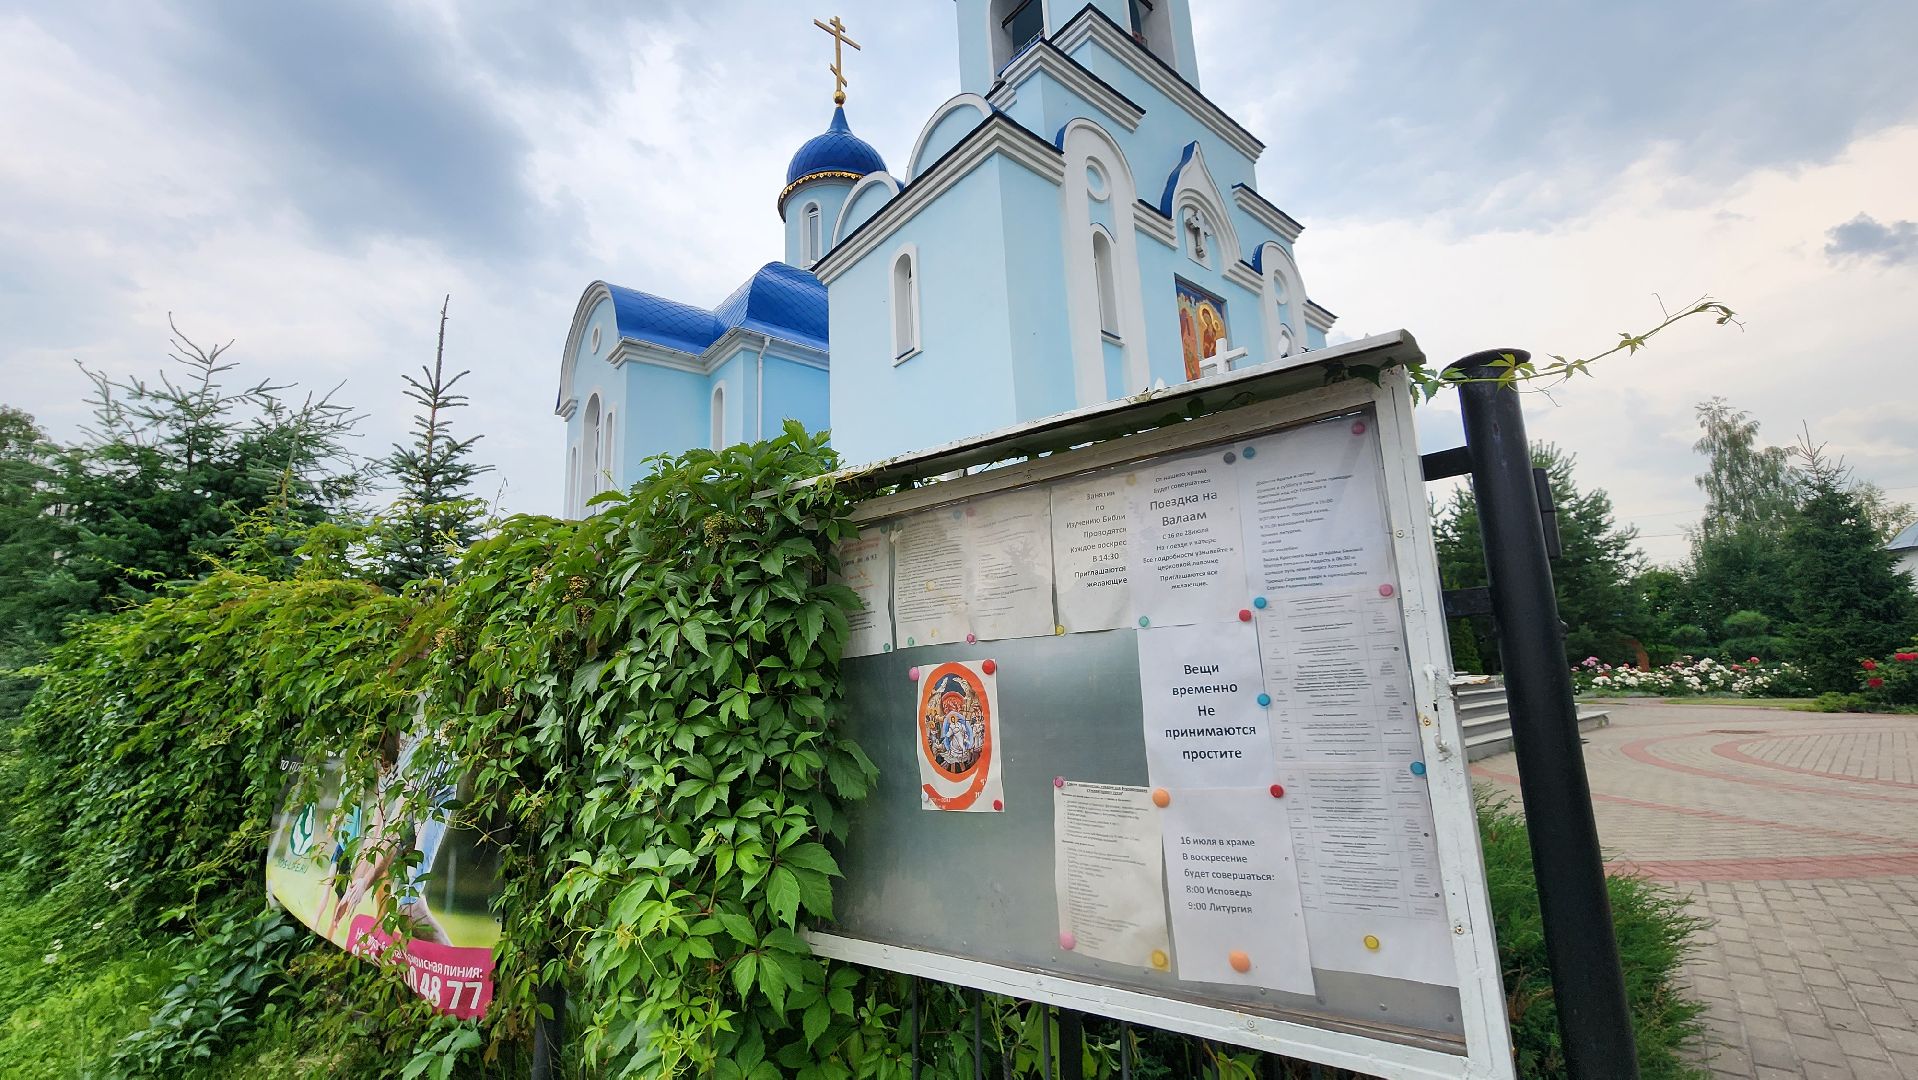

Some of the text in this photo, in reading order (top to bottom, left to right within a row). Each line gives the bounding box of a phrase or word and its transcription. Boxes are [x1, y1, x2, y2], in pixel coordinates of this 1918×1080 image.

[1171, 479, 1211, 489] совершаться
[1086, 491, 1115, 500] Занятия
[1150, 491, 1218, 511] Поездка на
[1066, 518, 1101, 529] Изучению
[1162, 512, 1207, 526] Валаам
[1083, 527, 1127, 538] Проводятся
[1070, 544, 1096, 553] Каждое
[1154, 552, 1194, 562] подробности
[1195, 547, 1228, 557] узнавайте
[1074, 565, 1127, 579] Приглашаются
[1160, 571, 1206, 582] Приглашаются
[1086, 577, 1128, 588] желающие
[1183, 664, 1220, 675] Вещи
[1172, 683, 1238, 698] временно
[1197, 705, 1216, 717] Не
[1165, 726, 1257, 740] принимаются
[1182, 749, 1242, 762] простите
[1180, 836, 1191, 845] 16
[1192, 837, 1217, 846] июля
[1226, 839, 1255, 848] храме
[1182, 852, 1248, 864] В воскресение
[1184, 868, 1275, 881] будет совершаться:
[1186, 885, 1253, 898] 8:00 Исповедь
[1187, 901, 1253, 914] 9:00 Литургия
[444, 964, 484, 980] линия:
[420, 972, 442, 1008] 48
[446, 980, 483, 1010] 77
